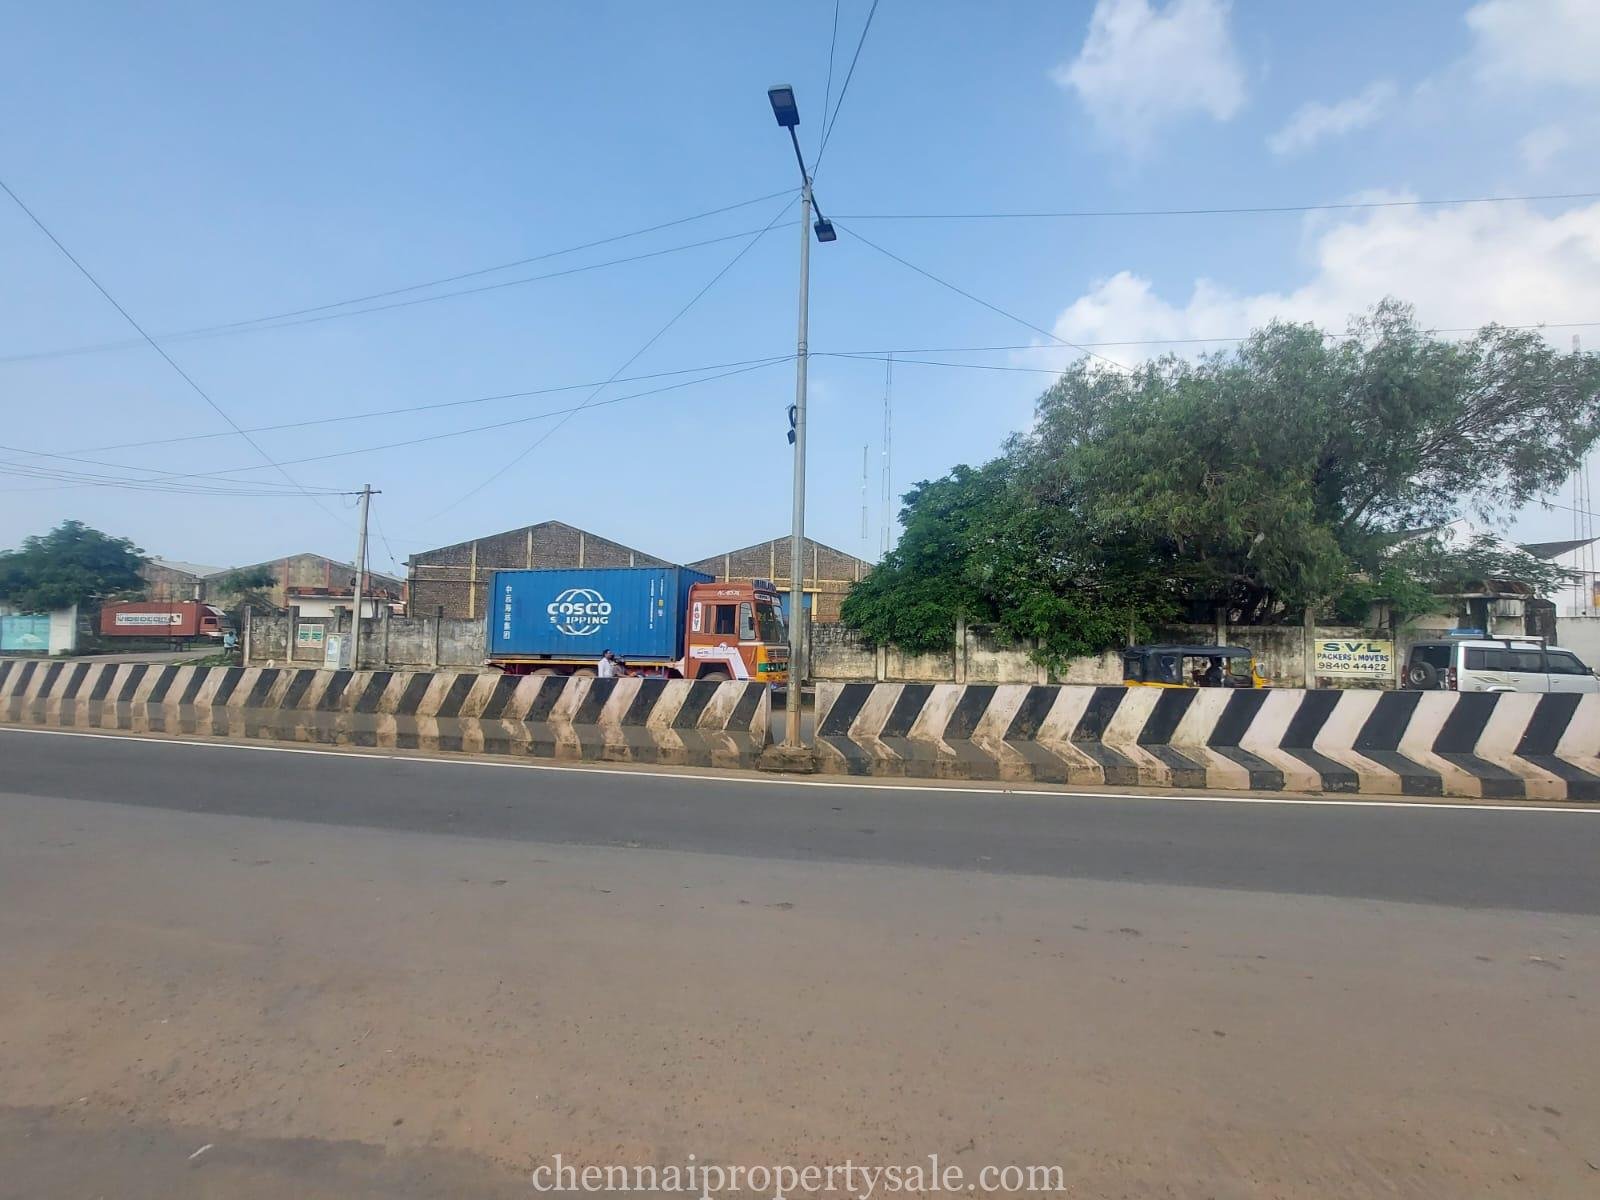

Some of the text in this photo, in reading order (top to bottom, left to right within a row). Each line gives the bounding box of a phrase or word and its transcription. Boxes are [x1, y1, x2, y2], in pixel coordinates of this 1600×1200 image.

[547, 602, 612, 615] COSCO
[550, 616, 609, 624] SIPPING
[1317, 653, 1352, 661] PACKERS
[1358, 654, 1389, 662] MOVERS
[1318, 662, 1387, 671] 98410 44422
